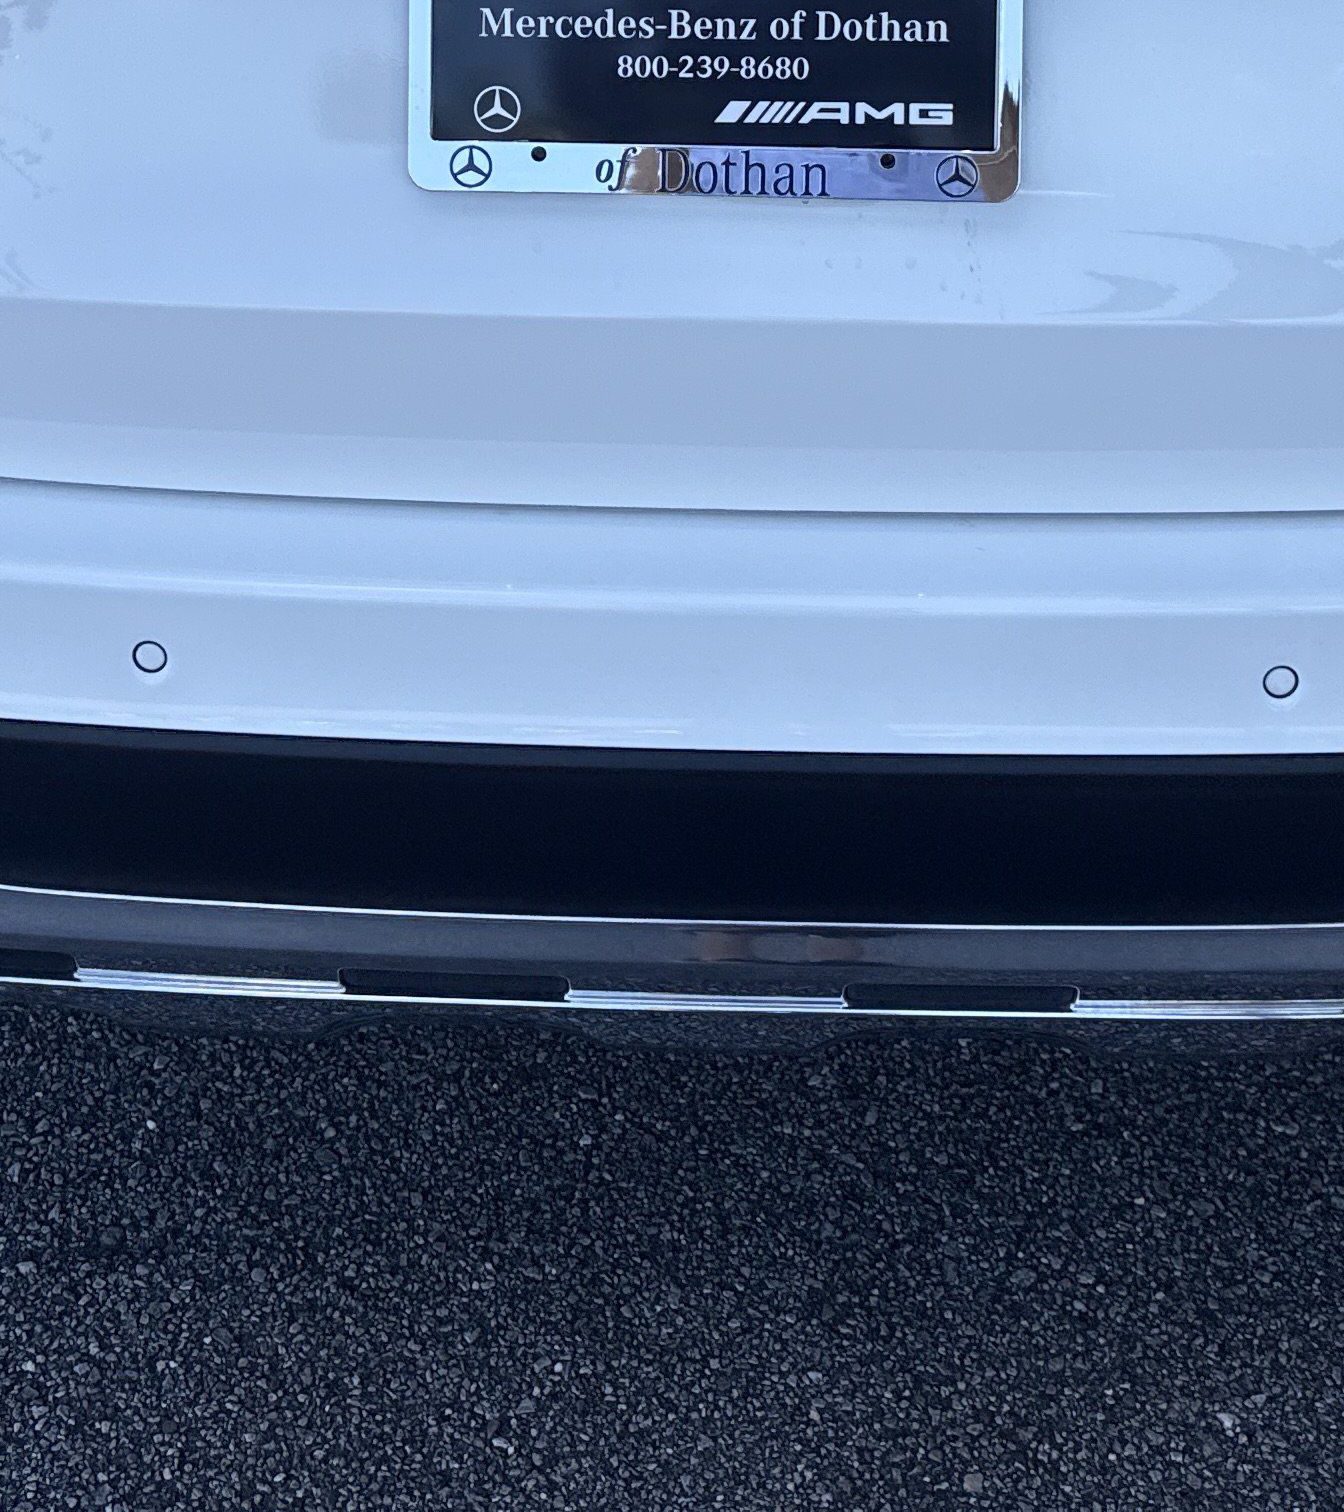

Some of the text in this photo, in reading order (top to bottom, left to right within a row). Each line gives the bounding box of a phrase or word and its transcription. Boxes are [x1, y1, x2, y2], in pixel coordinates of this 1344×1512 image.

[478, 6, 951, 44] Mercedes-Benz of Dothan
[617, 54, 810, 81] 800-239-8680
[798, 100, 954, 126] AMG
[595, 146, 831, 198] of Dothan
